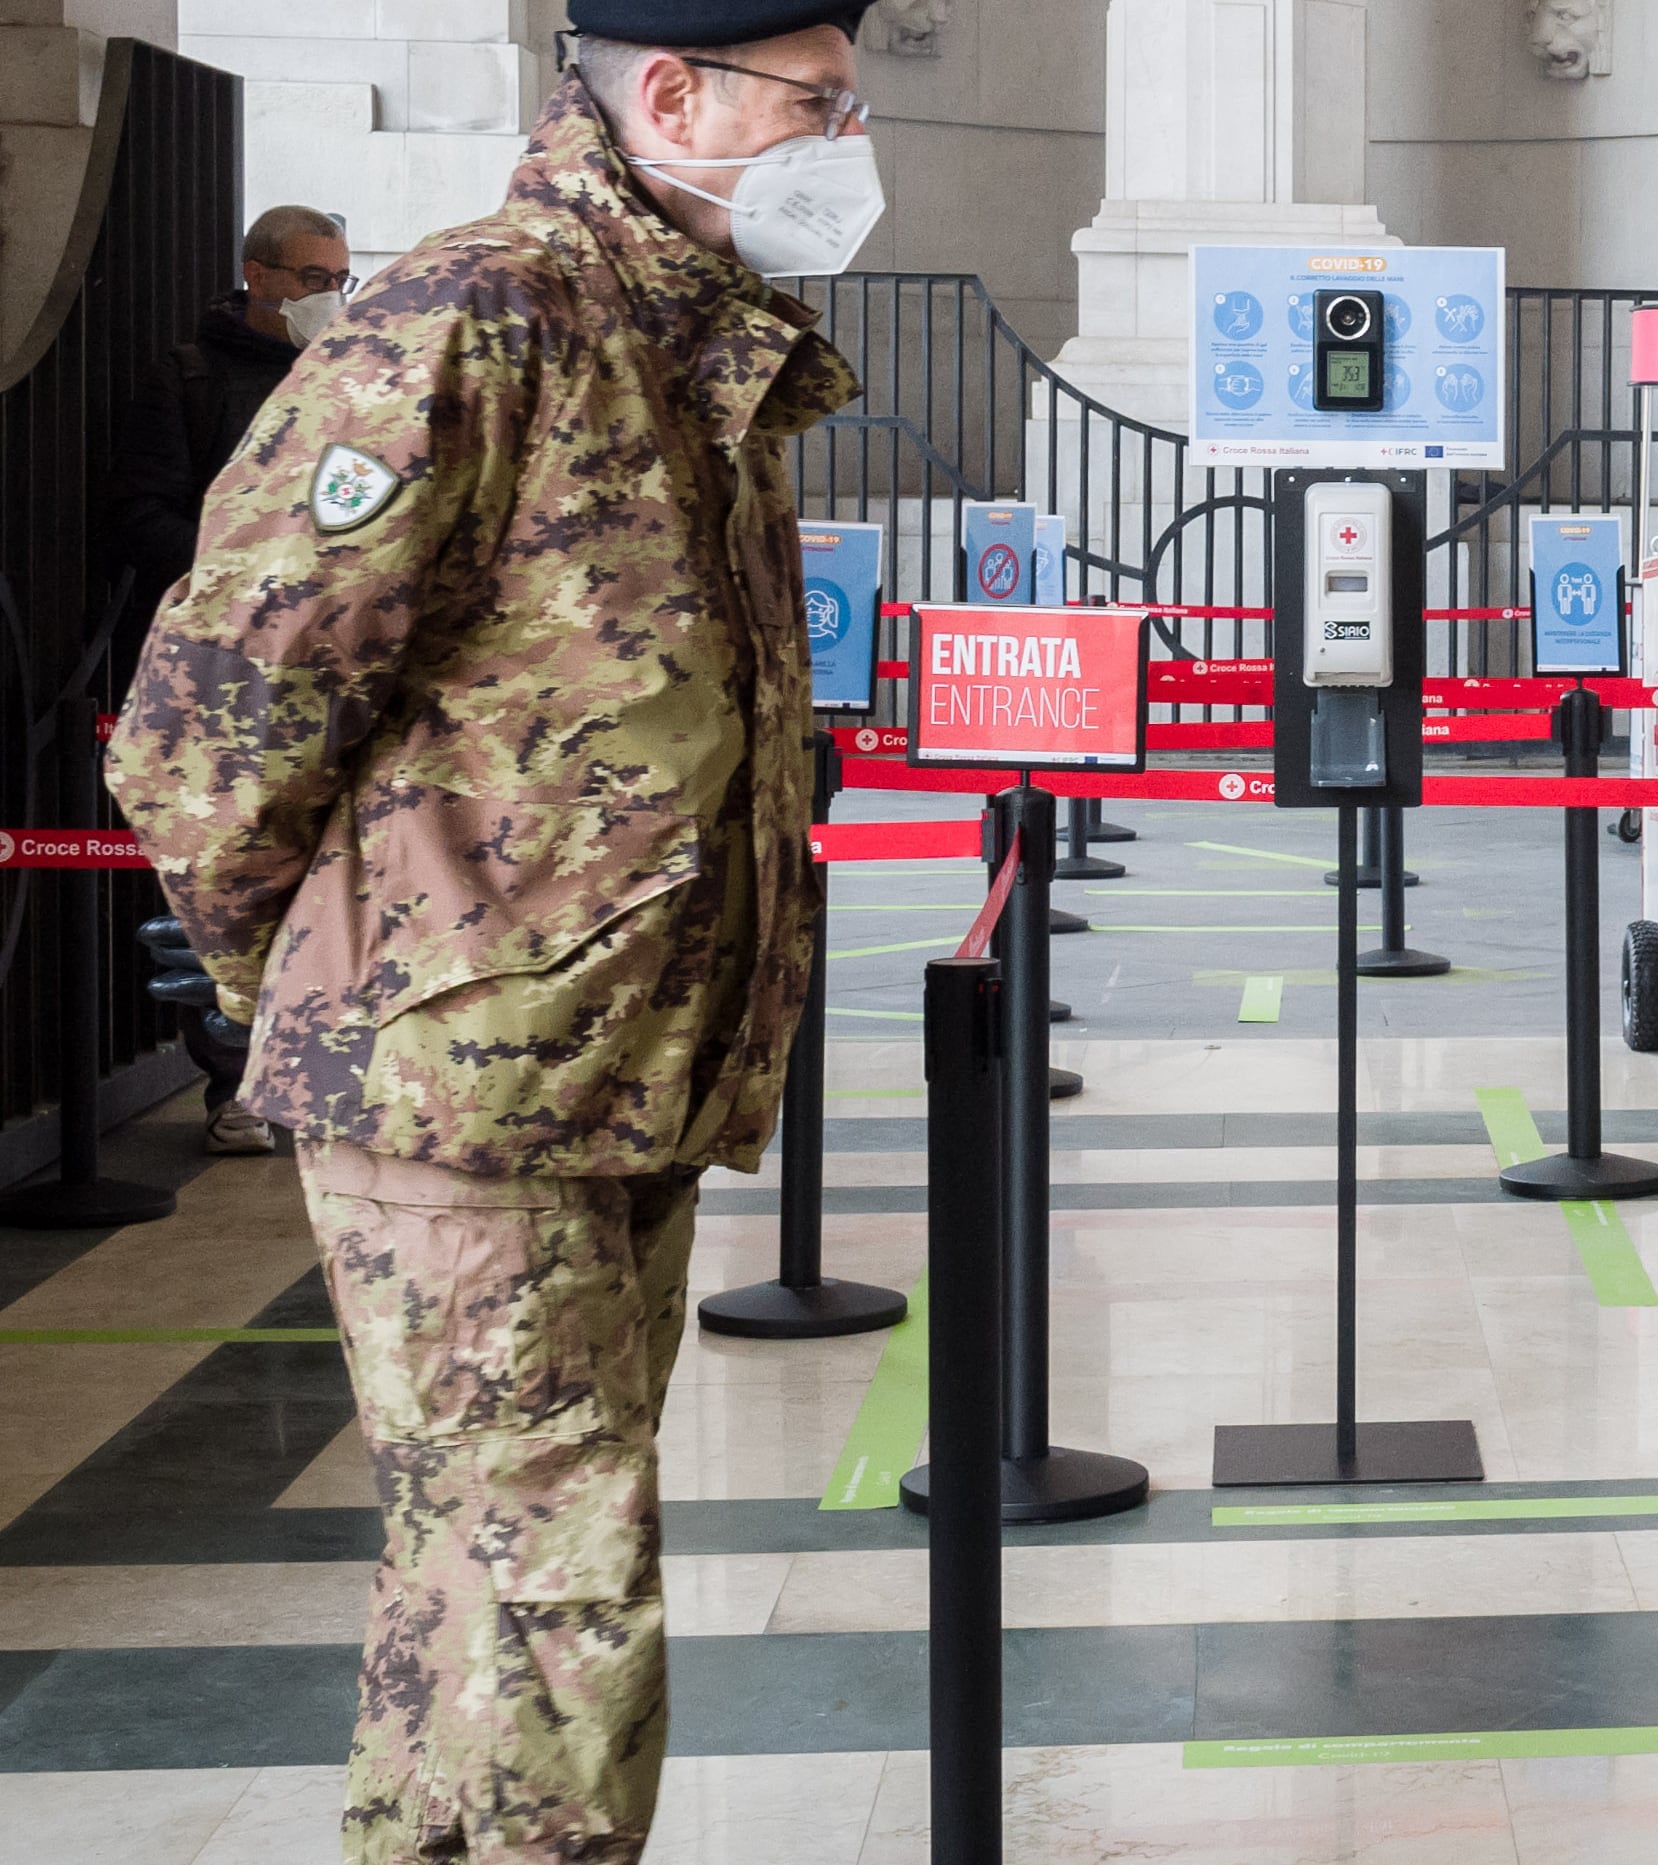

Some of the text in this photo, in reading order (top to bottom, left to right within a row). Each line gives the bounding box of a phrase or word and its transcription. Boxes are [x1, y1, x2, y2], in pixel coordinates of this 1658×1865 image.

[1310, 258, 1384, 271] COVID-19
[1223, 446, 1310, 455] Croce Rossa Italiana
[1395, 448, 1417, 456] IFRC
[1337, 626, 1369, 637] SIRIO
[931, 633, 1082, 679] ENTRATA
[1209, 663, 1237, 673] Croce
[1238, 662, 1268, 672] Rossa
[930, 684, 1100, 730] ENTRANCE
[882, 734, 908, 746] Cro
[20, 839, 81, 856] Croce
